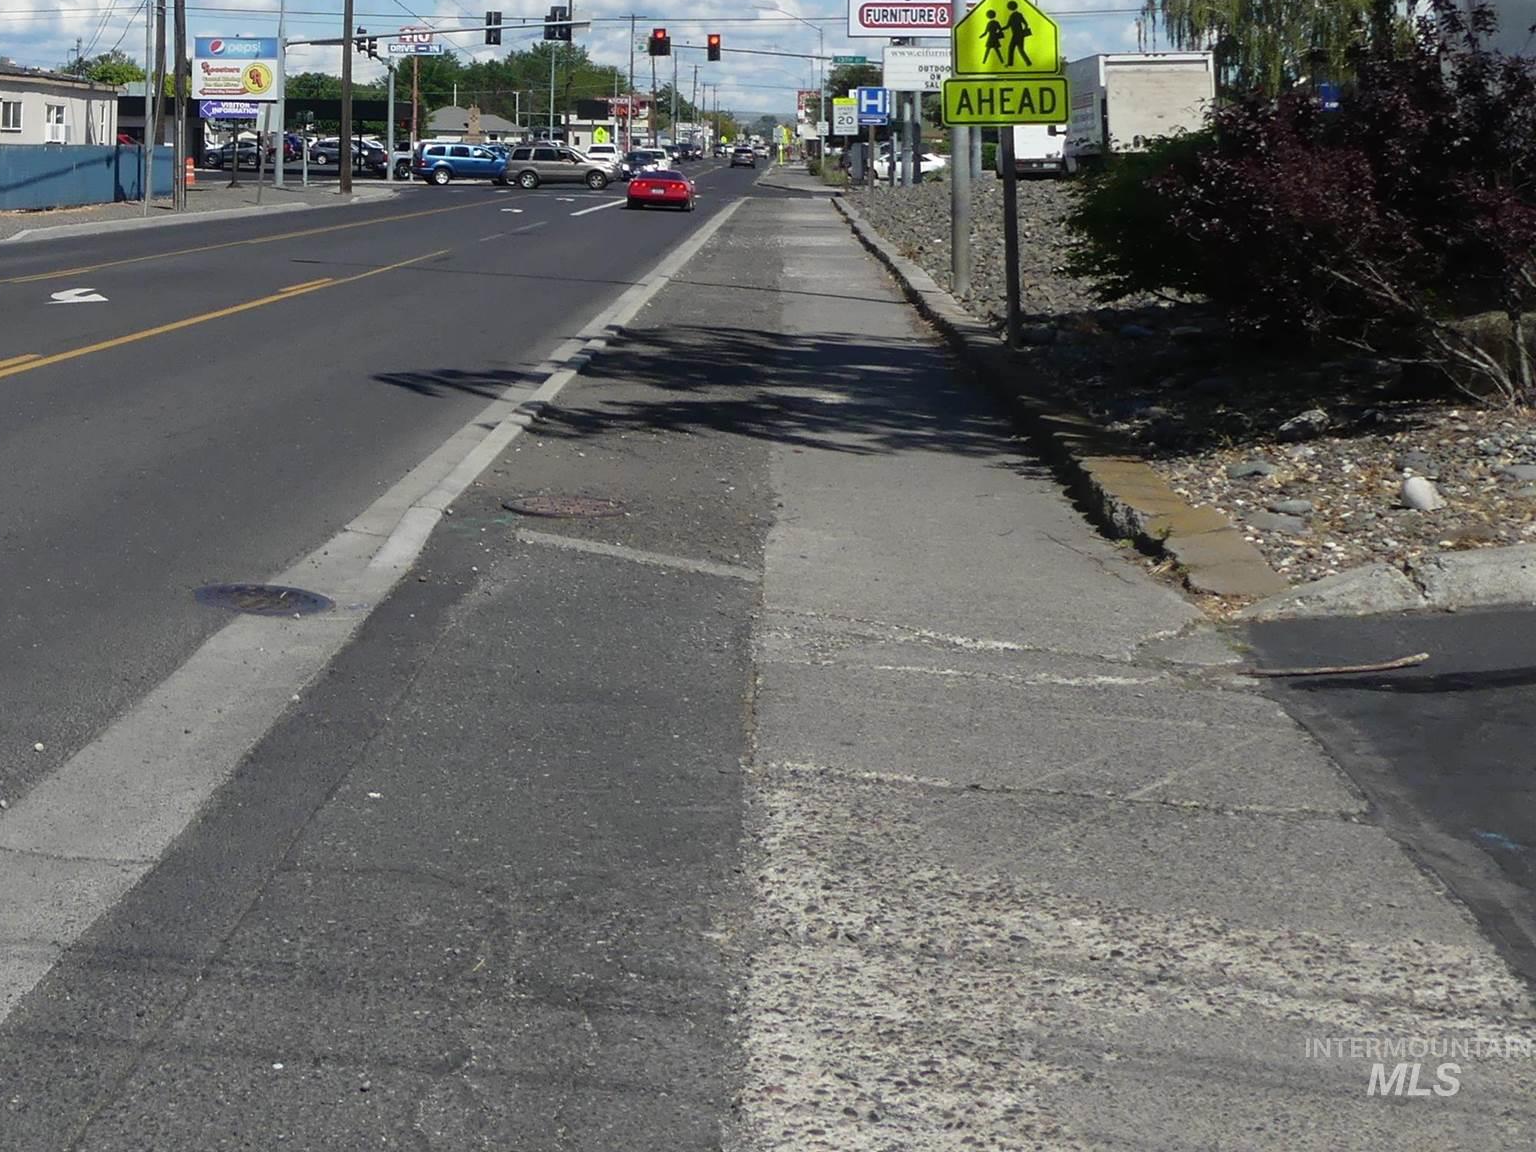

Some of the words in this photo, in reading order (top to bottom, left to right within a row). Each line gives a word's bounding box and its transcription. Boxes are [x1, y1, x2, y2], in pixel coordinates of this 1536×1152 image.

[865, 8, 934, 24] FURNITURE
[938, 8, 948, 24] &
[227, 40, 261, 53] pepsi
[925, 81, 940, 89] SAL
[861, 90, 883, 113] H
[956, 87, 1056, 115] AHEAD
[837, 115, 854, 125] 20
